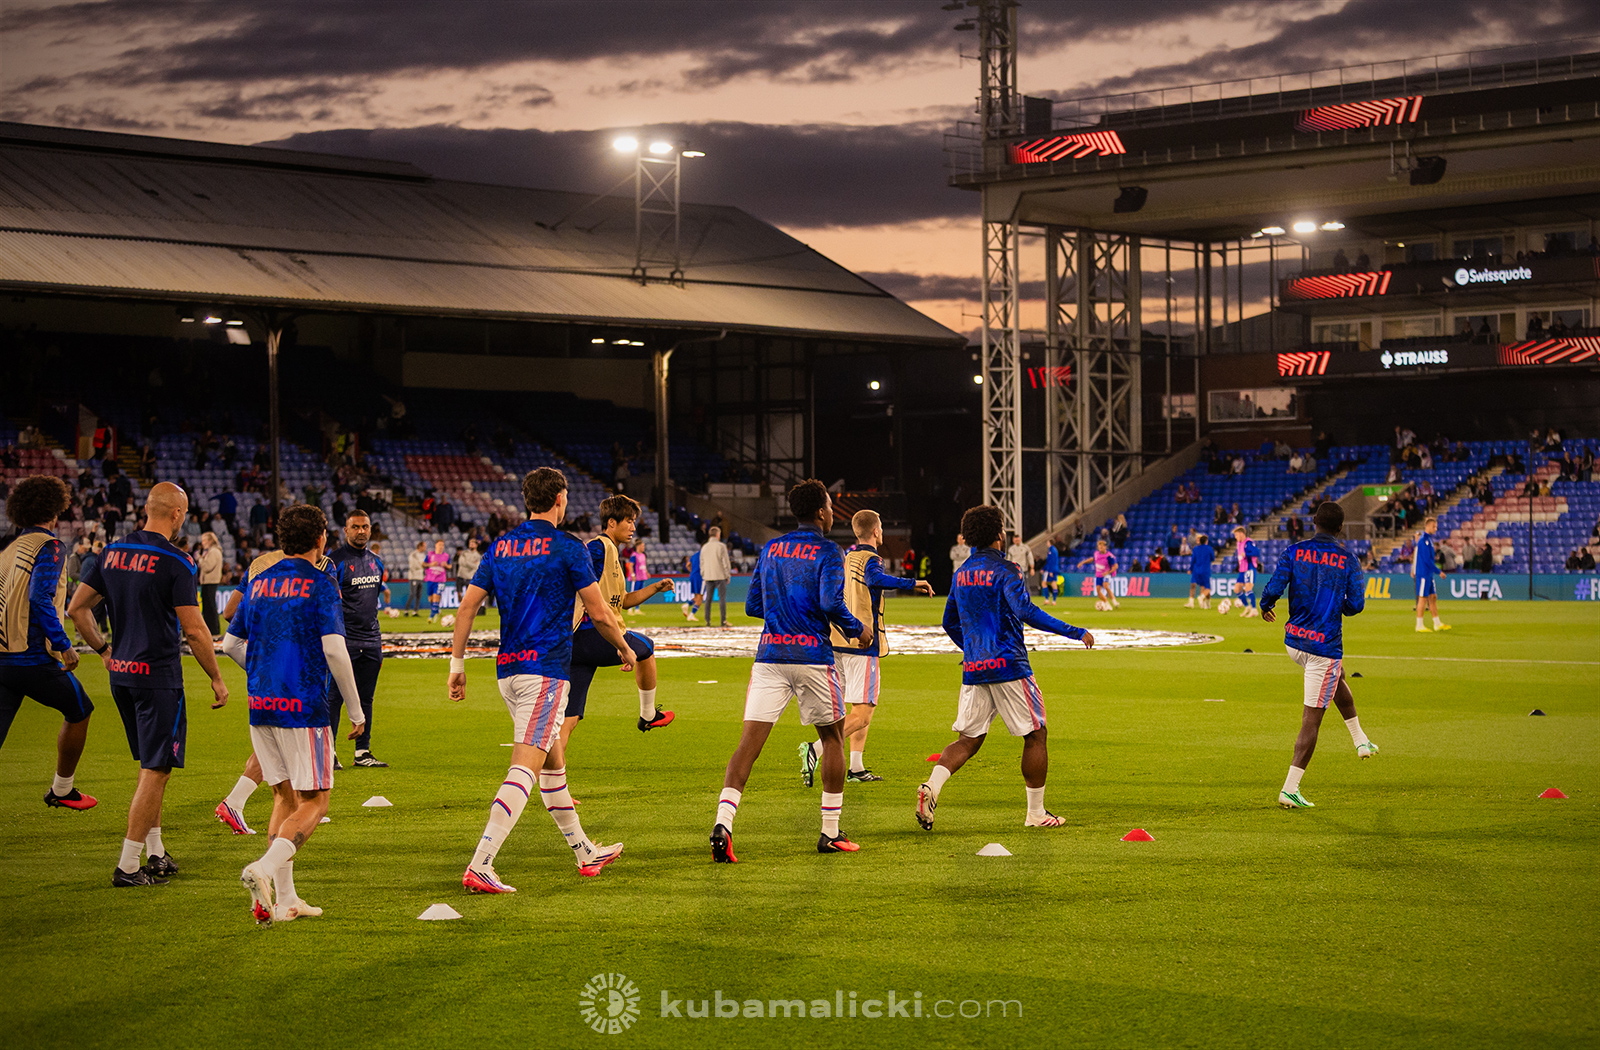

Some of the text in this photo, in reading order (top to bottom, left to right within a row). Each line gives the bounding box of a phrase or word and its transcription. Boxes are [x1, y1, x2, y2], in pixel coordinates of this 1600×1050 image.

[1469, 266, 1532, 284] Swissquote
[1394, 350, 1449, 366] STRAUSS
[495, 538, 552, 558] PALACE
[768, 542, 821, 560] PALACE
[104, 551, 159, 574] PALACE
[1296, 549, 1347, 570] PALACE
[351, 575, 380, 585] BROOKS
[957, 570, 994, 587] PALACE
[251, 578, 314, 600] PALACE
[1451, 579, 1503, 598] UEFA
[761, 633, 817, 647] macron
